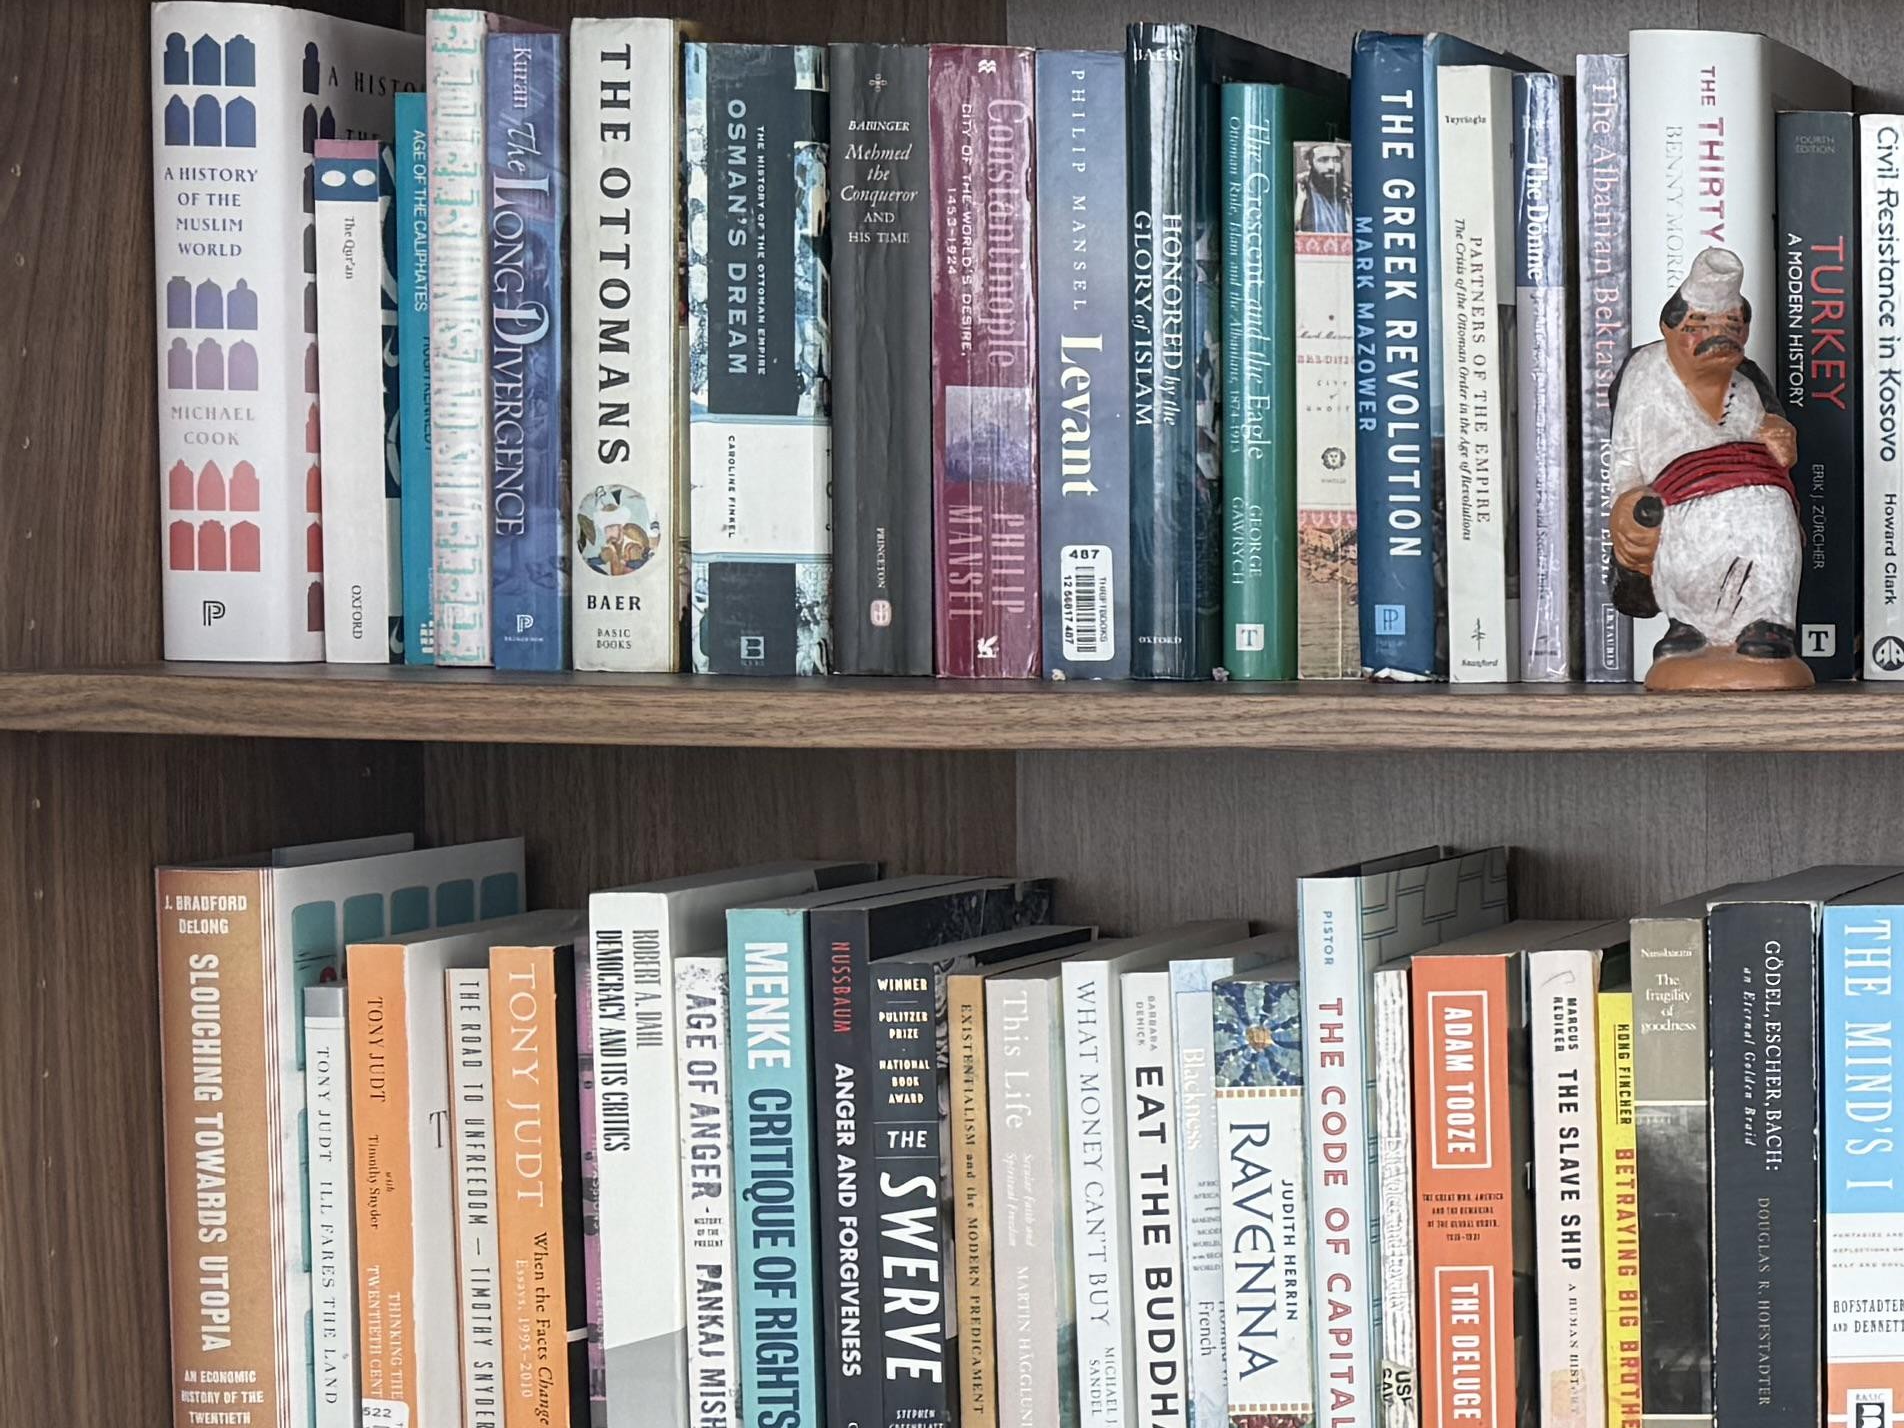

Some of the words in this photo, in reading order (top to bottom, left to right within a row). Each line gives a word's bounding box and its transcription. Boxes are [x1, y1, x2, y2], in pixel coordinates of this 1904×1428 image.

[599, 43, 631, 145] THE
[1380, 90, 1414, 159] THE
[164, 167, 175, 182] A
[181, 166, 258, 184] HISTORY
[176, 216, 244, 234] MUSLIM
[178, 192, 197, 207] OF
[205, 192, 240, 207] THE
[178, 241, 242, 258] WORLD
[1382, 178, 1417, 301] GREEK
[597, 167, 631, 466] OTTOMANS
[1808, 236, 1846, 410] TURKEY
[1059, 333, 1104, 497] Levant
[1384, 319, 1422, 557] REVOLUTION
[586, 593, 641, 612] BAER
[189, 952, 225, 1102] SLOUCHING
[744, 942, 791, 1069] MENKE
[1442, 1007, 1473, 1073] ADAM
[743, 1088, 797, 1250] CRITIQUE
[886, 1129, 927, 1150] THE
[1445, 1083, 1477, 1155] TOOZE
[196, 1113, 227, 1242] TOWARDS
[755, 1258, 799, 1300] OF
[879, 1170, 943, 1385] SWERVE
[1226, 1121, 1279, 1384] RAVENNA
[1453, 1281, 1479, 1324] THE
[199, 1253, 231, 1353] UTOPIA
[1453, 1335, 1481, 1422] DELUGE
